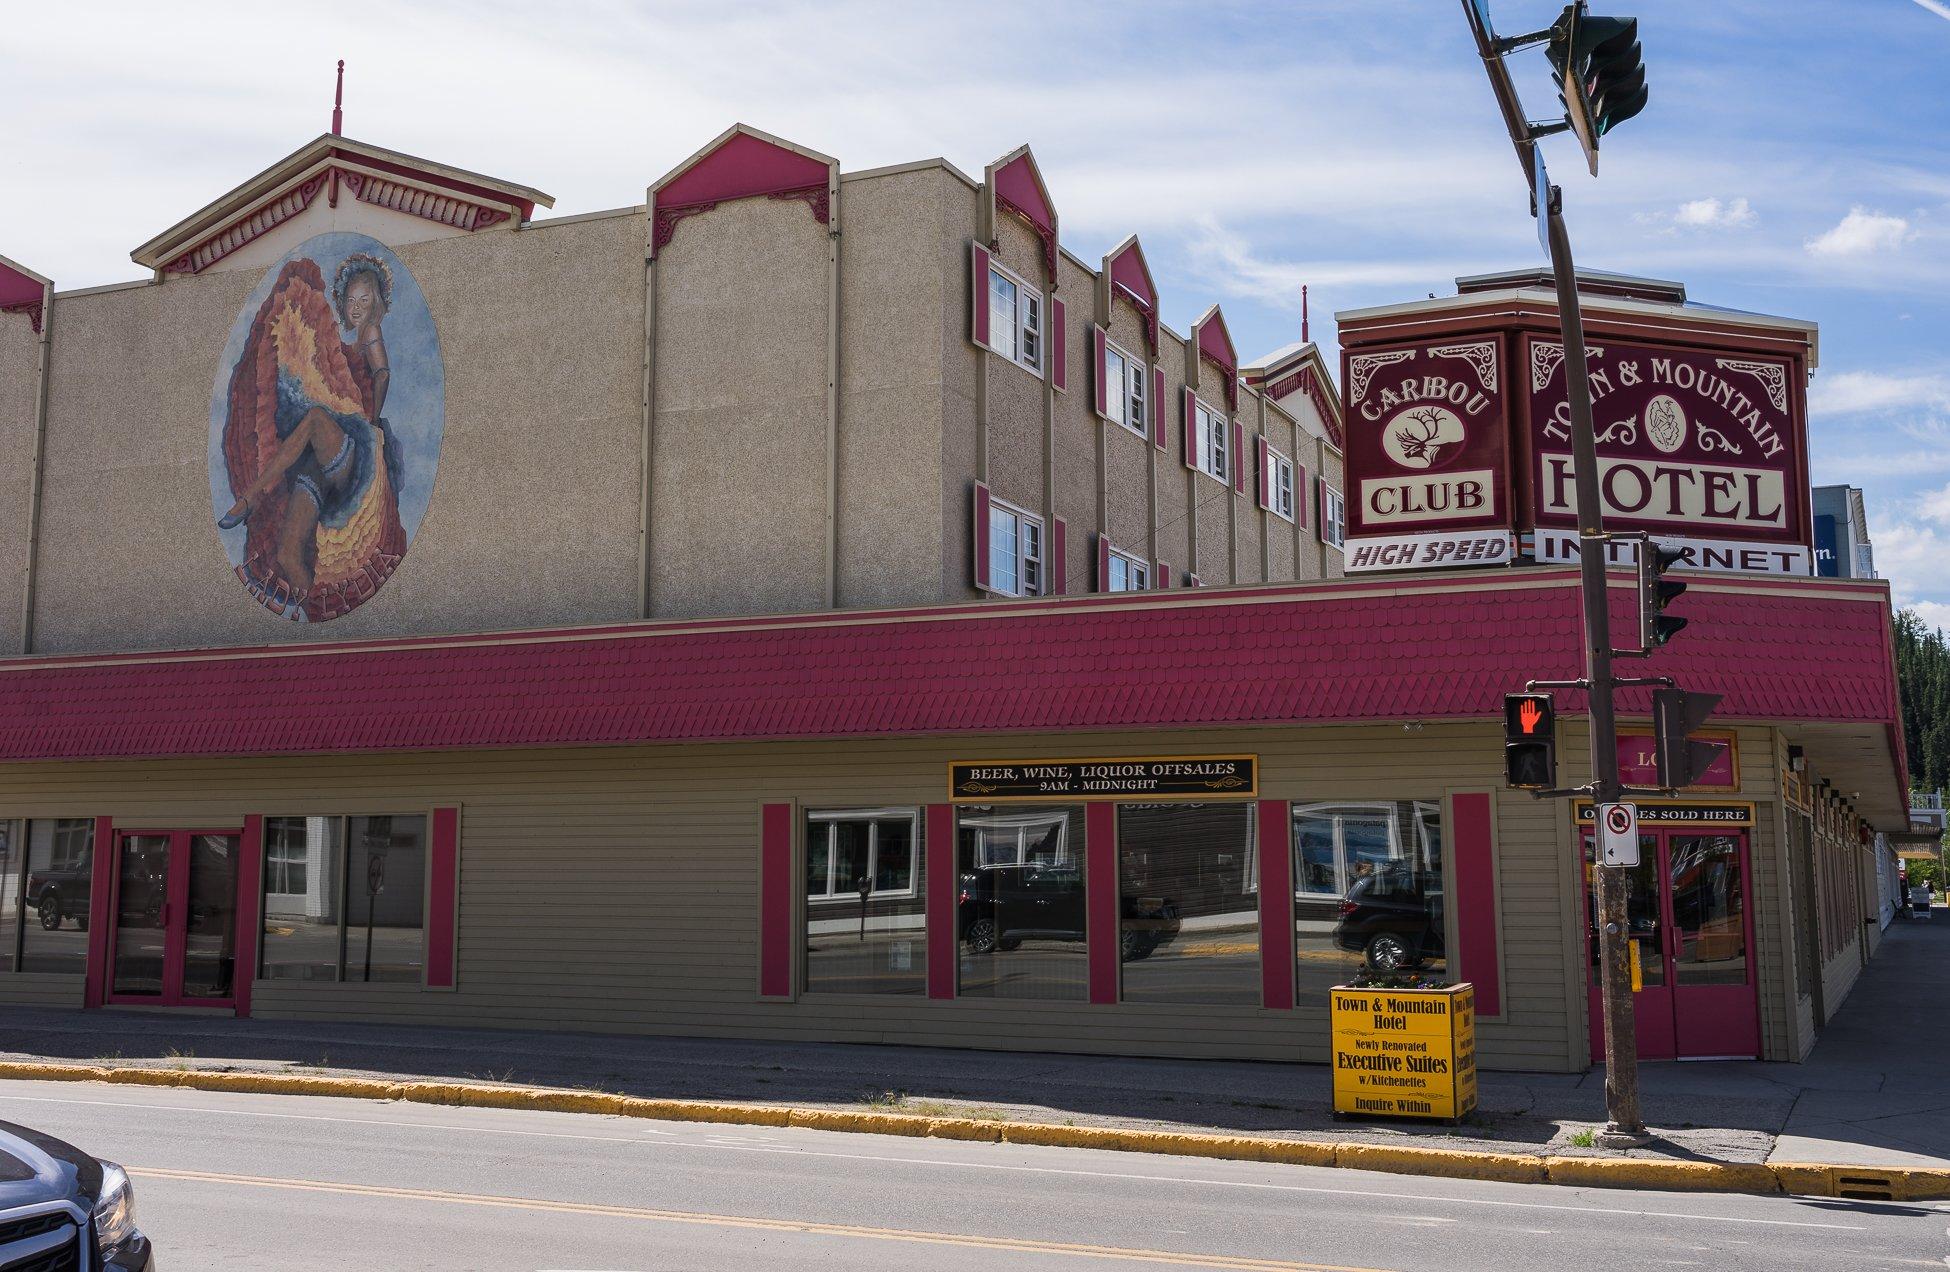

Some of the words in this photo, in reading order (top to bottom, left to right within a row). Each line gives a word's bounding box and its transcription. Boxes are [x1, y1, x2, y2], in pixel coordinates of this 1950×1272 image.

[1361, 376, 1490, 421] CARIBOU
[1542, 368, 1615, 442] TON
[1618, 360, 1643, 386] &
[1651, 358, 1785, 459] MOUNTAIN
[1370, 480, 1486, 517] CLUB
[1351, 543, 1418, 567] HIGH
[1421, 538, 1506, 563] SPEED
[1545, 537, 1800, 572] INTRNET
[234, 552, 308, 620] LADY
[321, 548, 402, 622] LYDIA
[970, 768, 1018, 781] BEER,
[1023, 766, 1072, 779] WINE,
[1080, 765, 1146, 779] LIQUOR
[1151, 763, 1236, 776] OFFSALES
[1040, 781, 1070, 791] 9AM
[1082, 780, 1158, 790] MIDNIGHT
[1660, 810, 1699, 820] SOLD
[1703, 811, 1745, 820] HERE
[1335, 996, 1368, 1012] Town
[1372, 998, 1382, 1012] &
[1387, 998, 1446, 1014] Mountain
[1374, 1015, 1406, 1030] Hotel
[1355, 1039, 1379, 1051] Newly
[1382, 1040, 1426, 1052] Renovated
[1338, 1052, 1402, 1072] Executive
[1406, 1055, 1447, 1074] Suites
[1355, 1097, 1393, 1111] Inquire
[1397, 1100, 1431, 1113] Within
